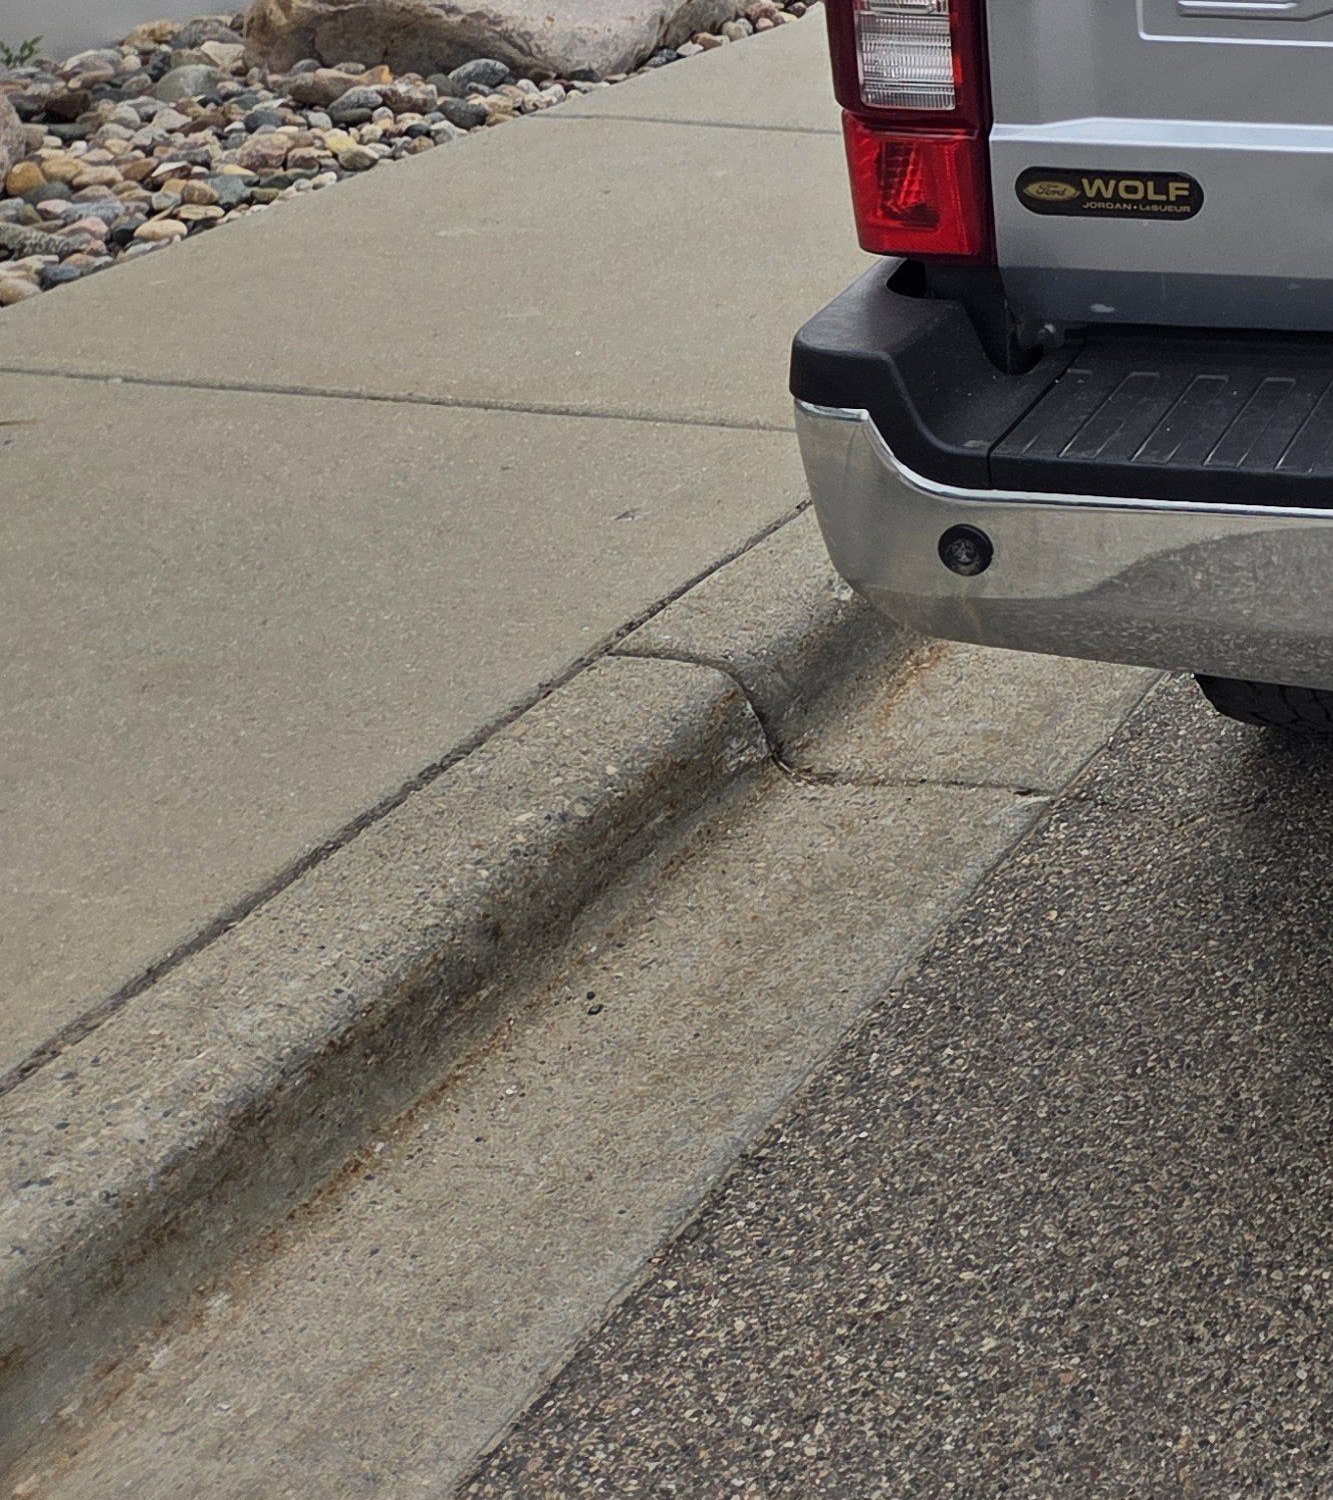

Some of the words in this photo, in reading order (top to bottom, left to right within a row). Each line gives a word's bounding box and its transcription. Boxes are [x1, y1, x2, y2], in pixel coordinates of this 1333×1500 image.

[1035, 183, 1067, 197] Ford
[1082, 178, 1190, 201] WOLF
[1082, 201, 1132, 211] JORDAN
